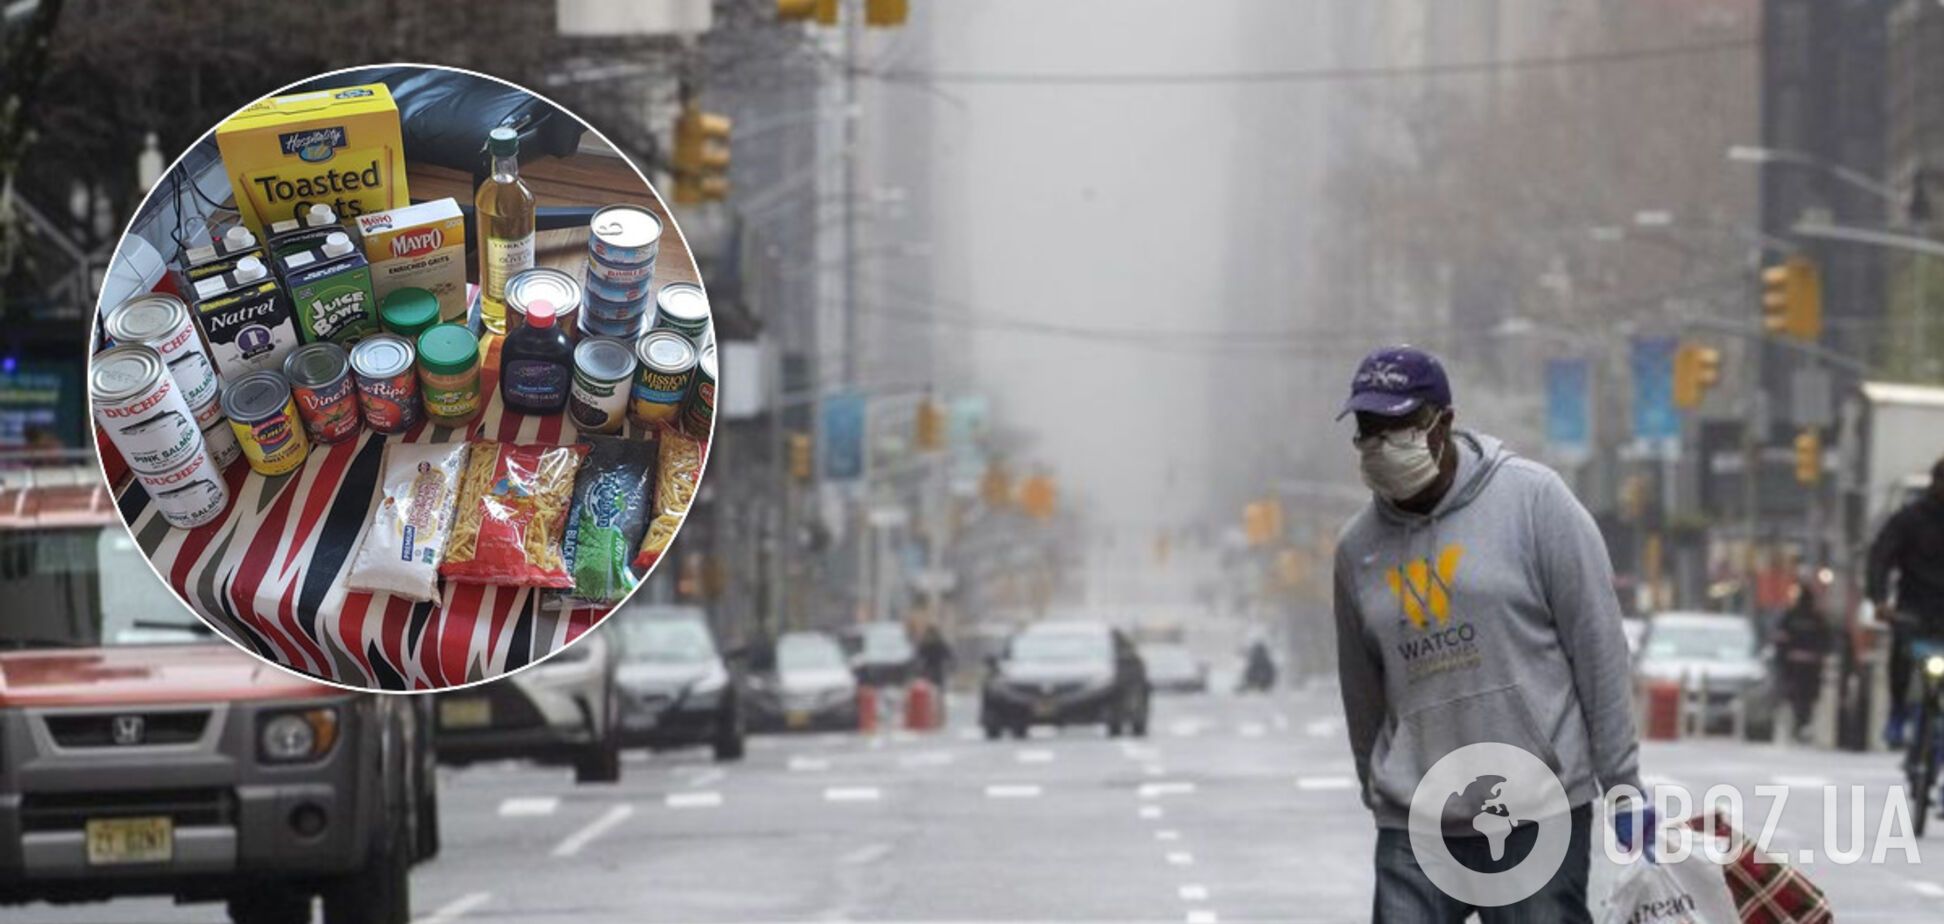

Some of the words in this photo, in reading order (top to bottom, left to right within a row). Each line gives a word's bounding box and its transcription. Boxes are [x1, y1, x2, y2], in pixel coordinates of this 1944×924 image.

[254, 161, 379, 202] Toasted
[293, 199, 362, 227] Ots
[392, 229, 441, 258] MAYPO
[211, 298, 275, 333] Natrel
[312, 291, 364, 320] JUICE
[313, 302, 362, 336] BOWL
[374, 382, 406, 400] Ripe
[642, 368, 689, 386] MISSION
[103, 379, 171, 418] DUCHESS
[303, 391, 341, 410] Vine
[133, 454, 160, 463] PINK
[162, 428, 195, 457] SALMON
[144, 454, 204, 486] DUCHESS
[403, 526, 414, 560] PREMIUM
[563, 529, 578, 557] BLACK
[1398, 622, 1475, 661] WATCO
